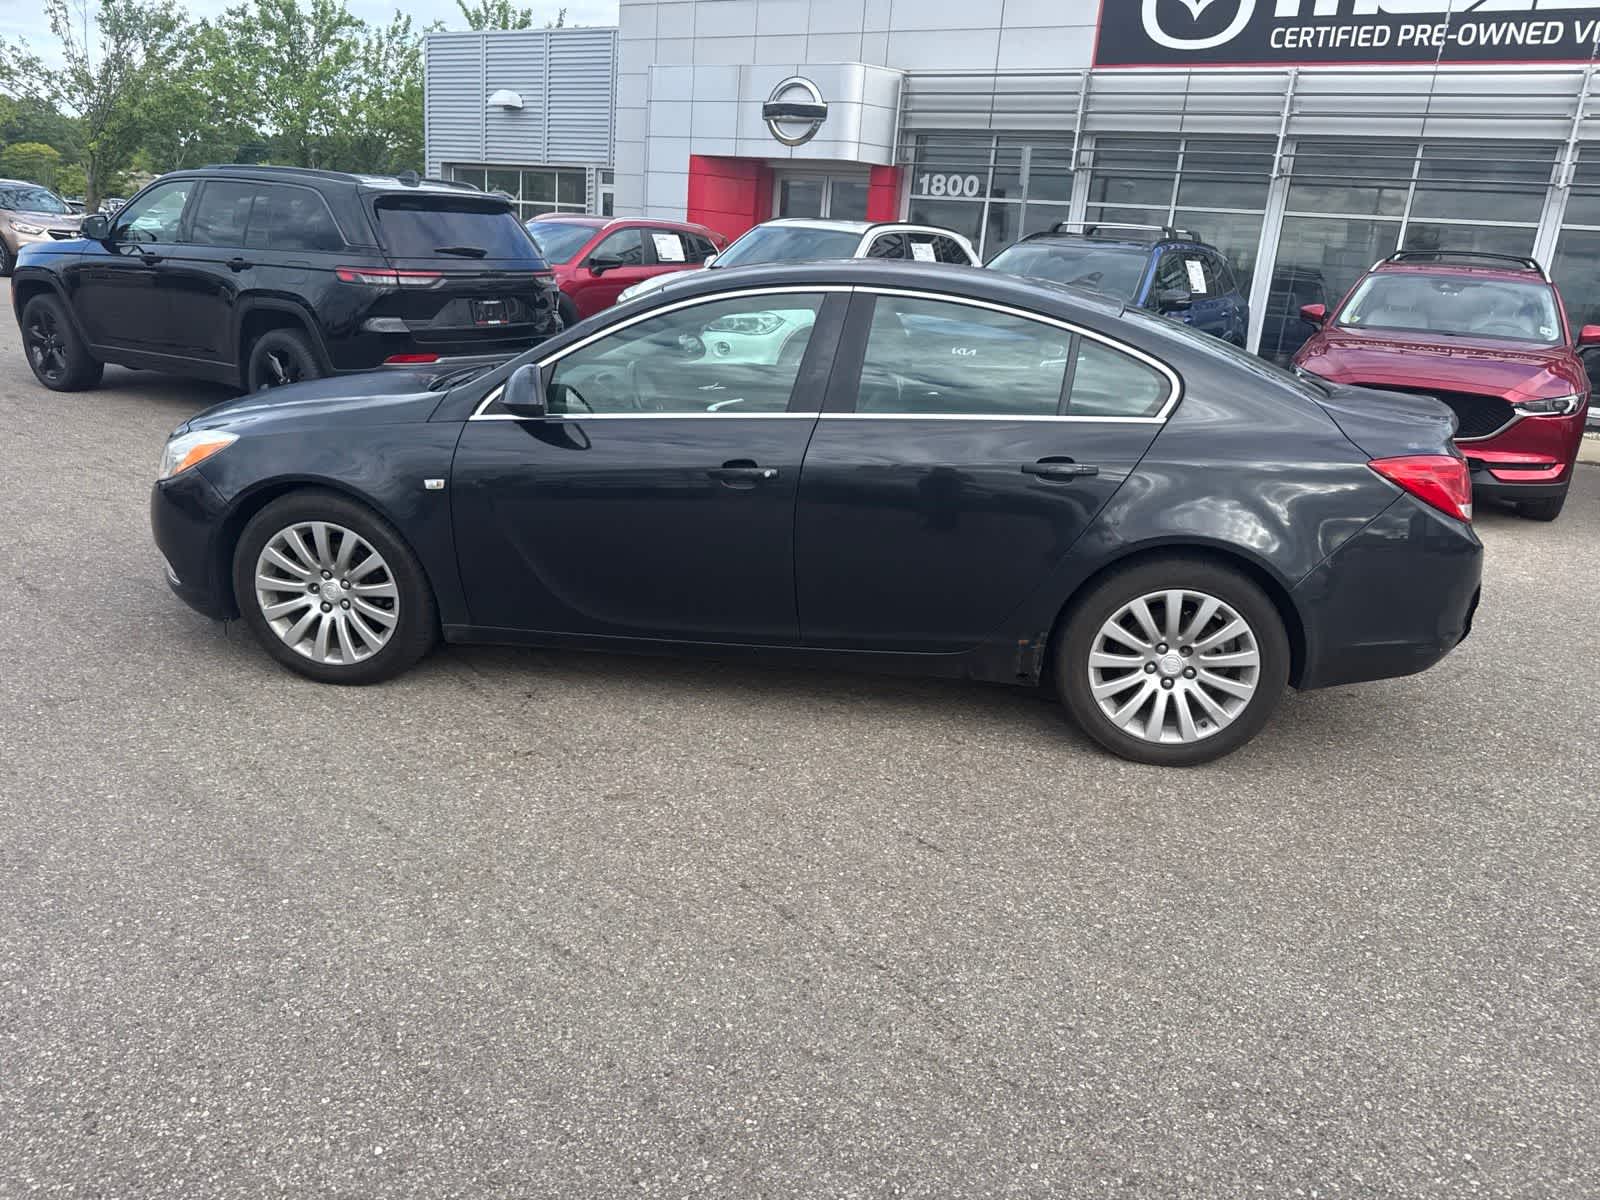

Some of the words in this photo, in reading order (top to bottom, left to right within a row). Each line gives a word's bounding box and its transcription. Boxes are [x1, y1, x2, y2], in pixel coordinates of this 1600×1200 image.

[1270, 24, 1391, 49] CERTIFIED
[1397, 21, 1565, 47] PRE-OWNED
[919, 173, 980, 197] 1800
